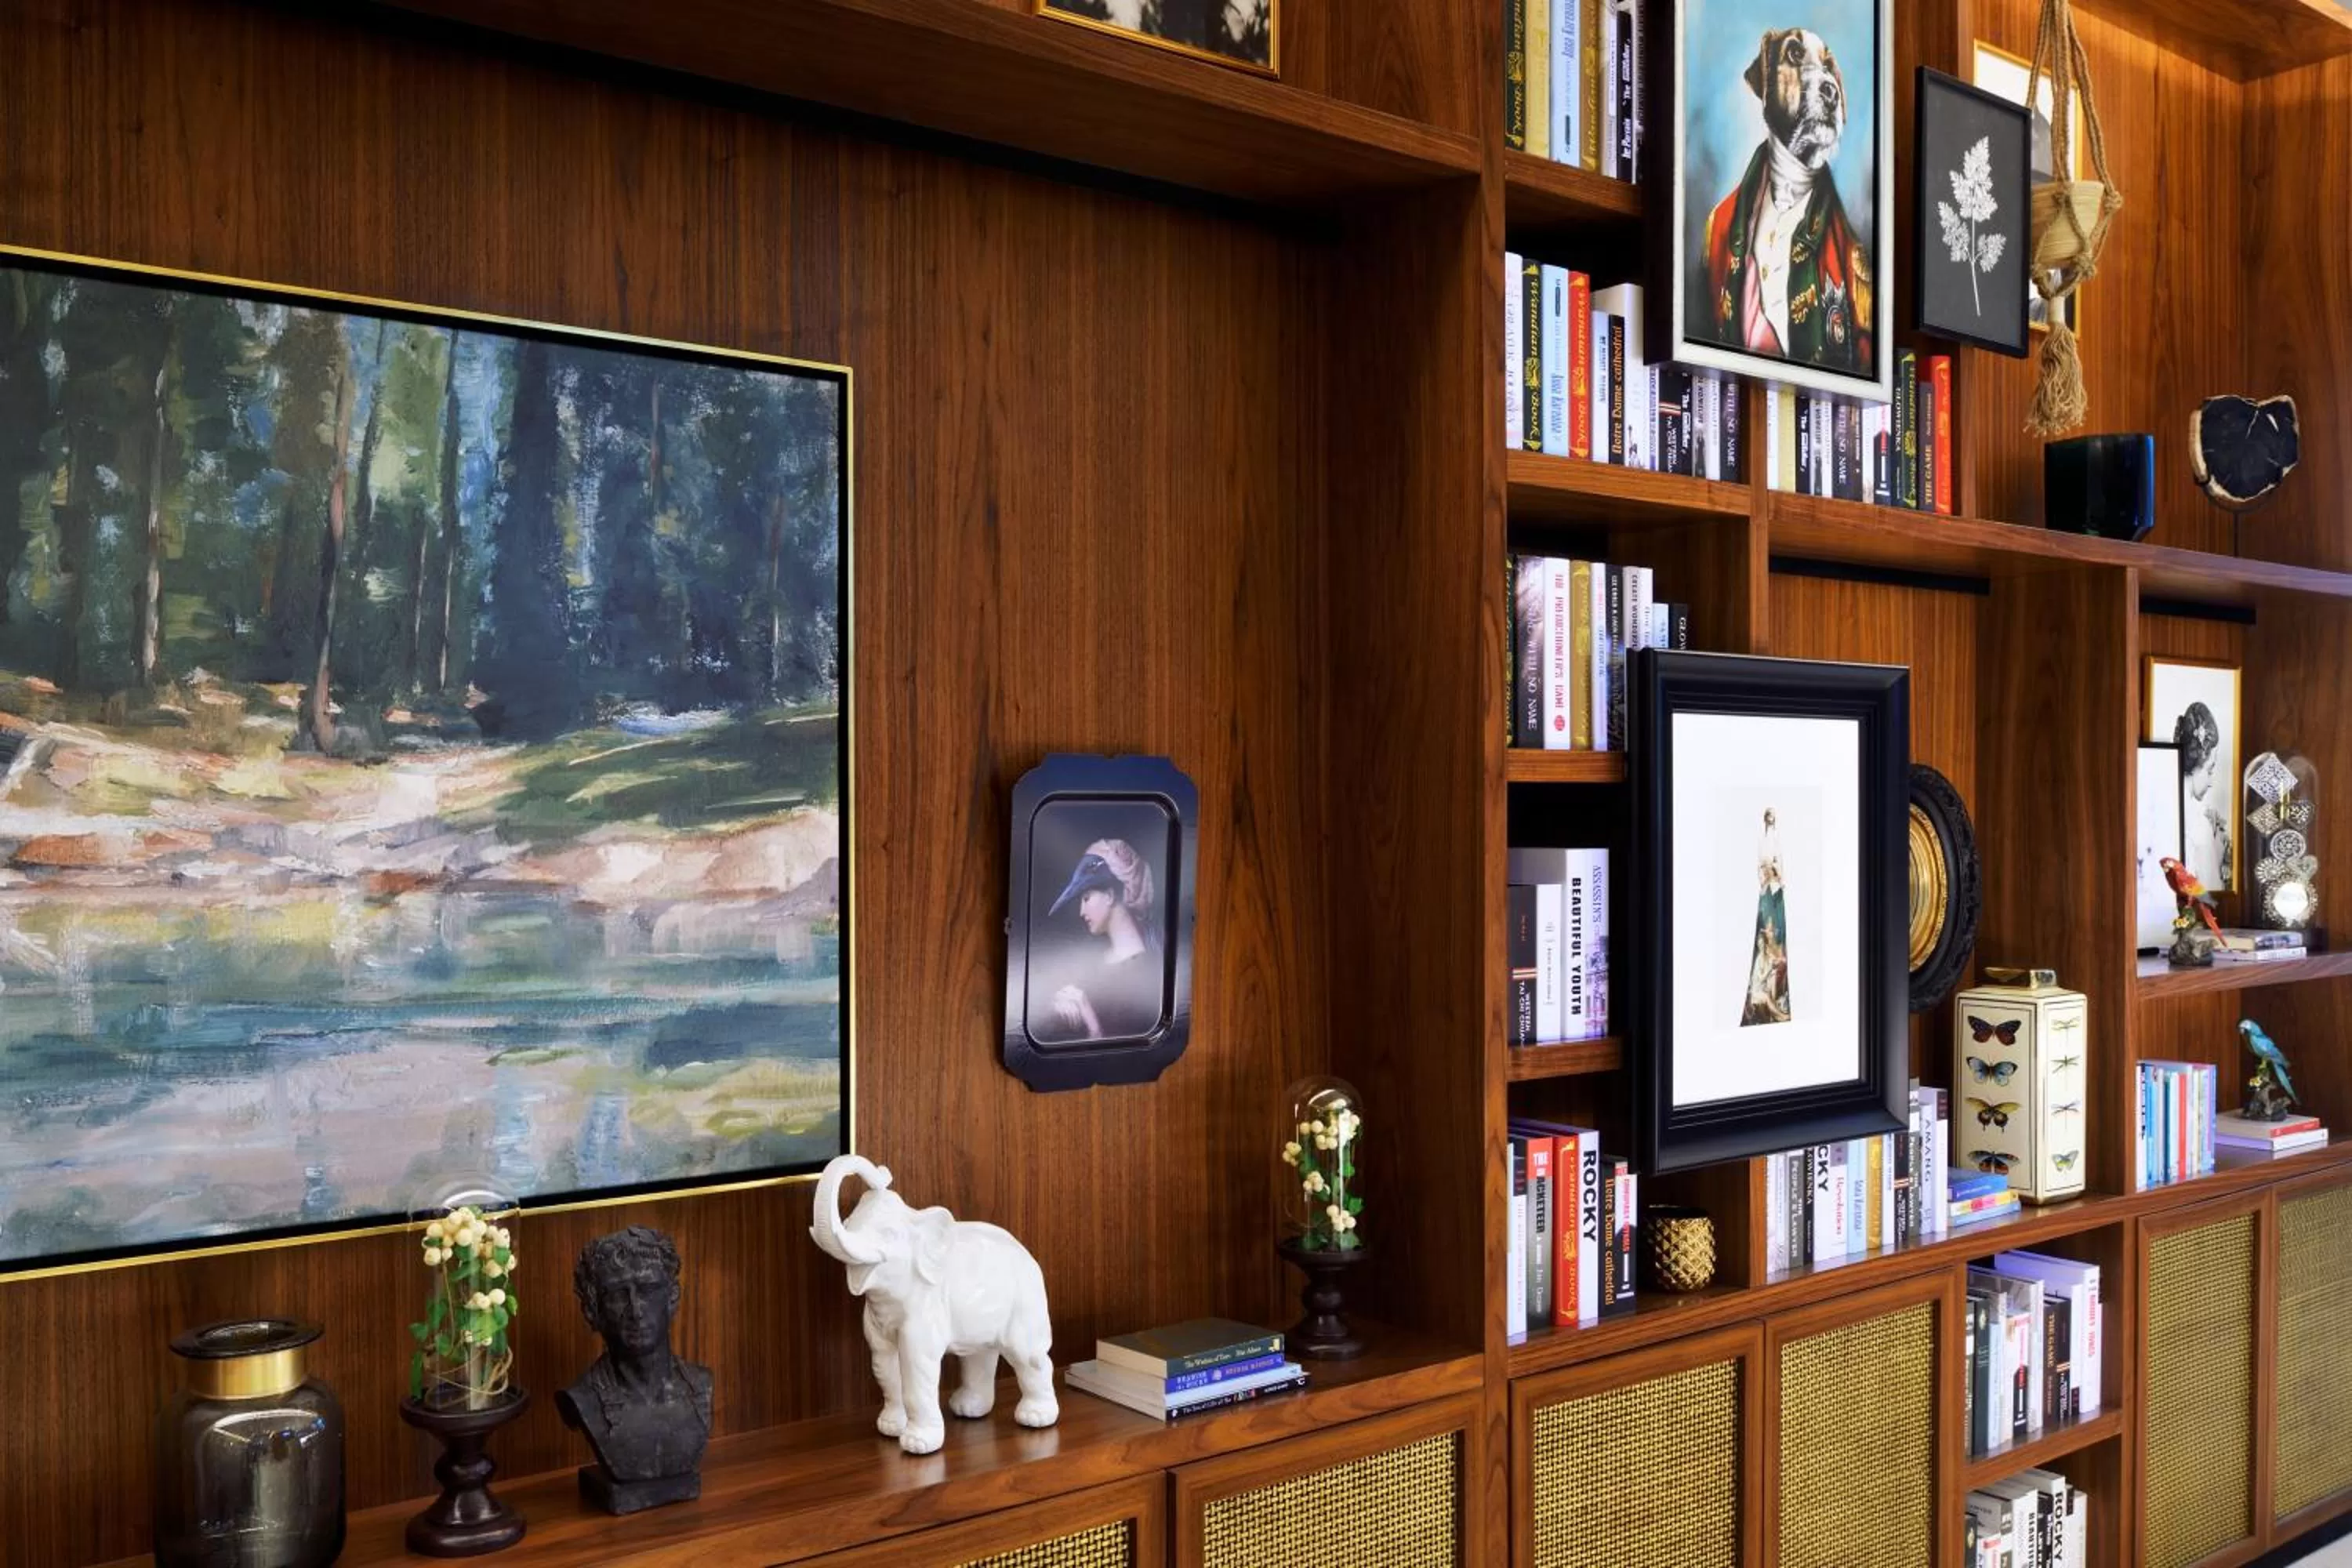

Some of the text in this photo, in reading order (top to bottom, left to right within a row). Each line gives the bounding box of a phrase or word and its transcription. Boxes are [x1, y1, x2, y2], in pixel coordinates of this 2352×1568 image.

[1571, 877, 1582, 1015] BEAUTIFUL YOUTH
[1583, 1149, 1597, 1242] ROCKY
[1817, 1145, 1830, 1192] CKY
[1605, 1213, 1616, 1247] Dame
[1605, 1250, 1616, 1305] cathedral
[2053, 1491, 2063, 1562] ROCKY
